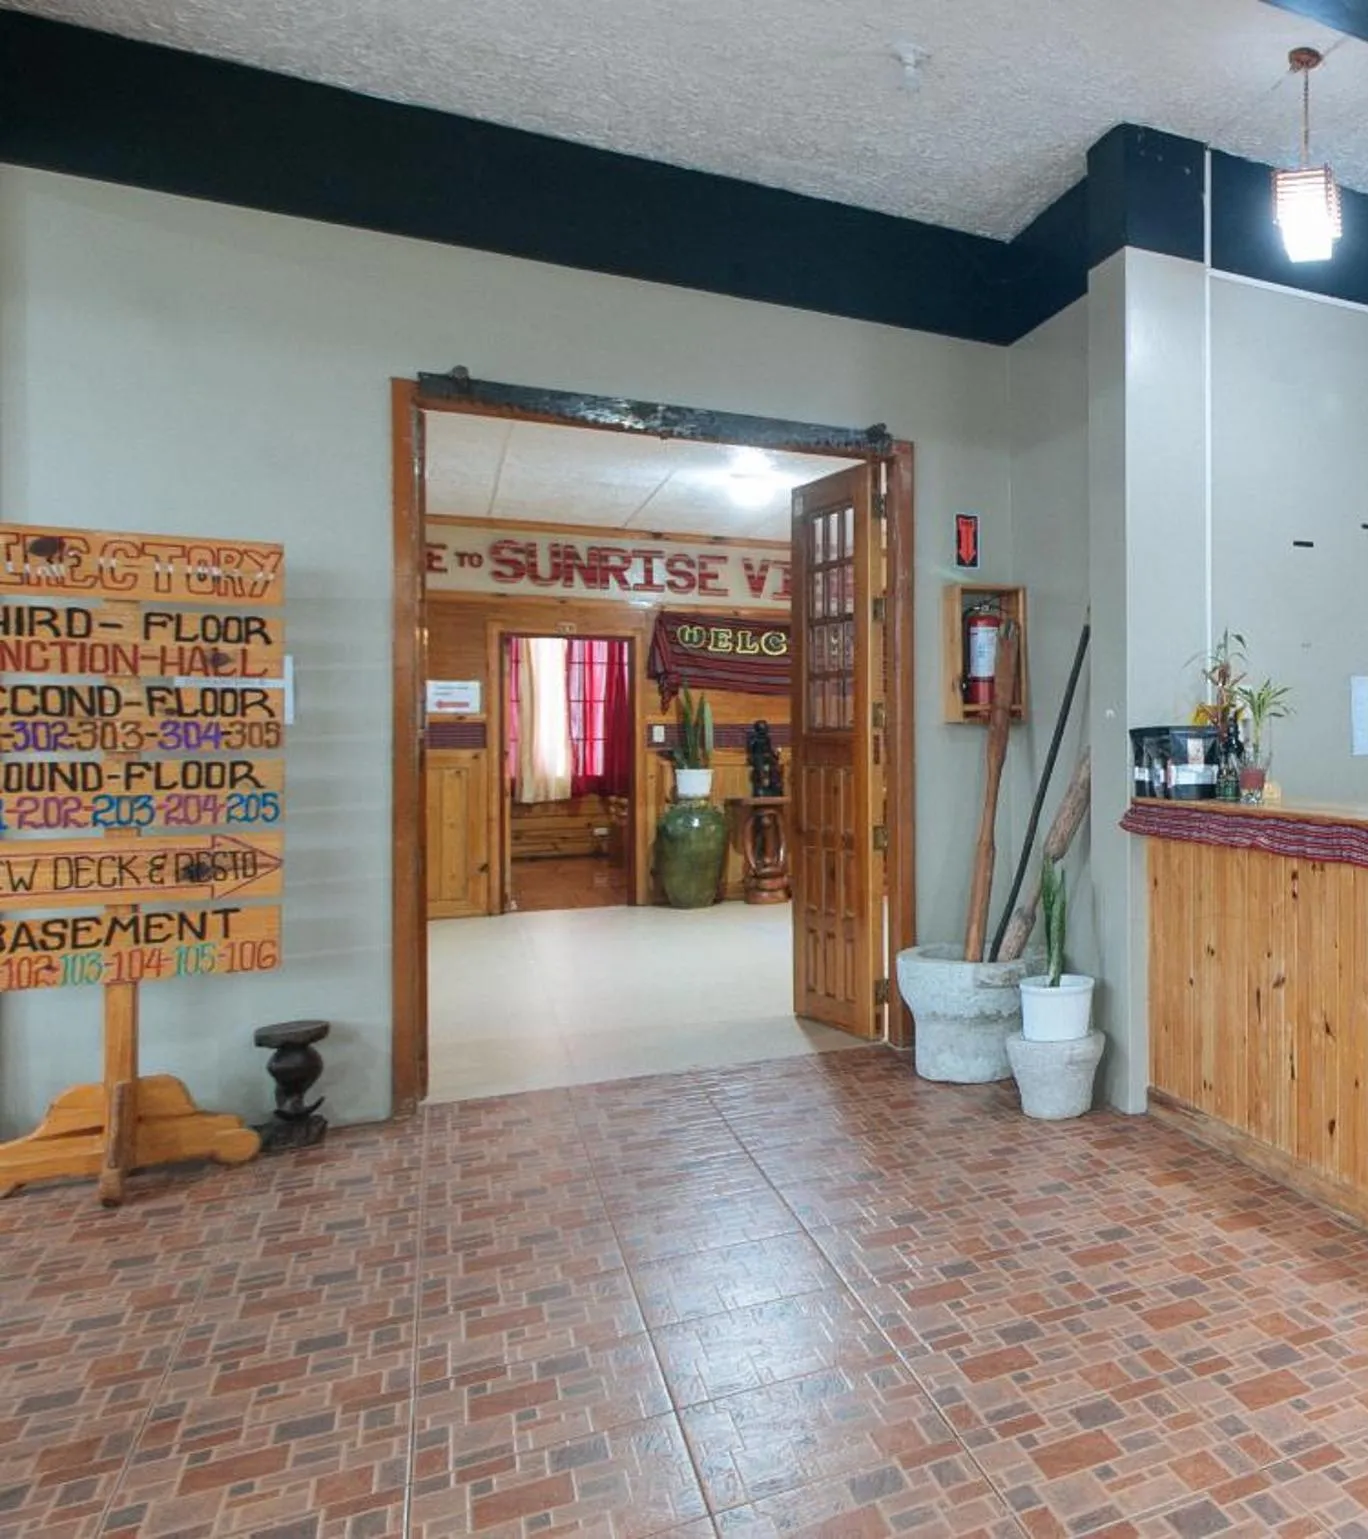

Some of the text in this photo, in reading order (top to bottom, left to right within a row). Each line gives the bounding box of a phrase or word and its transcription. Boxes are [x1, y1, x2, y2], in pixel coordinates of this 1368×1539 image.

[454, 551, 484, 569] TO
[489, 539, 729, 598] SUNRISE
[144, 612, 272, 646] FLOOR
[53, 855, 141, 890] DECK
[148, 853, 168, 885] &
